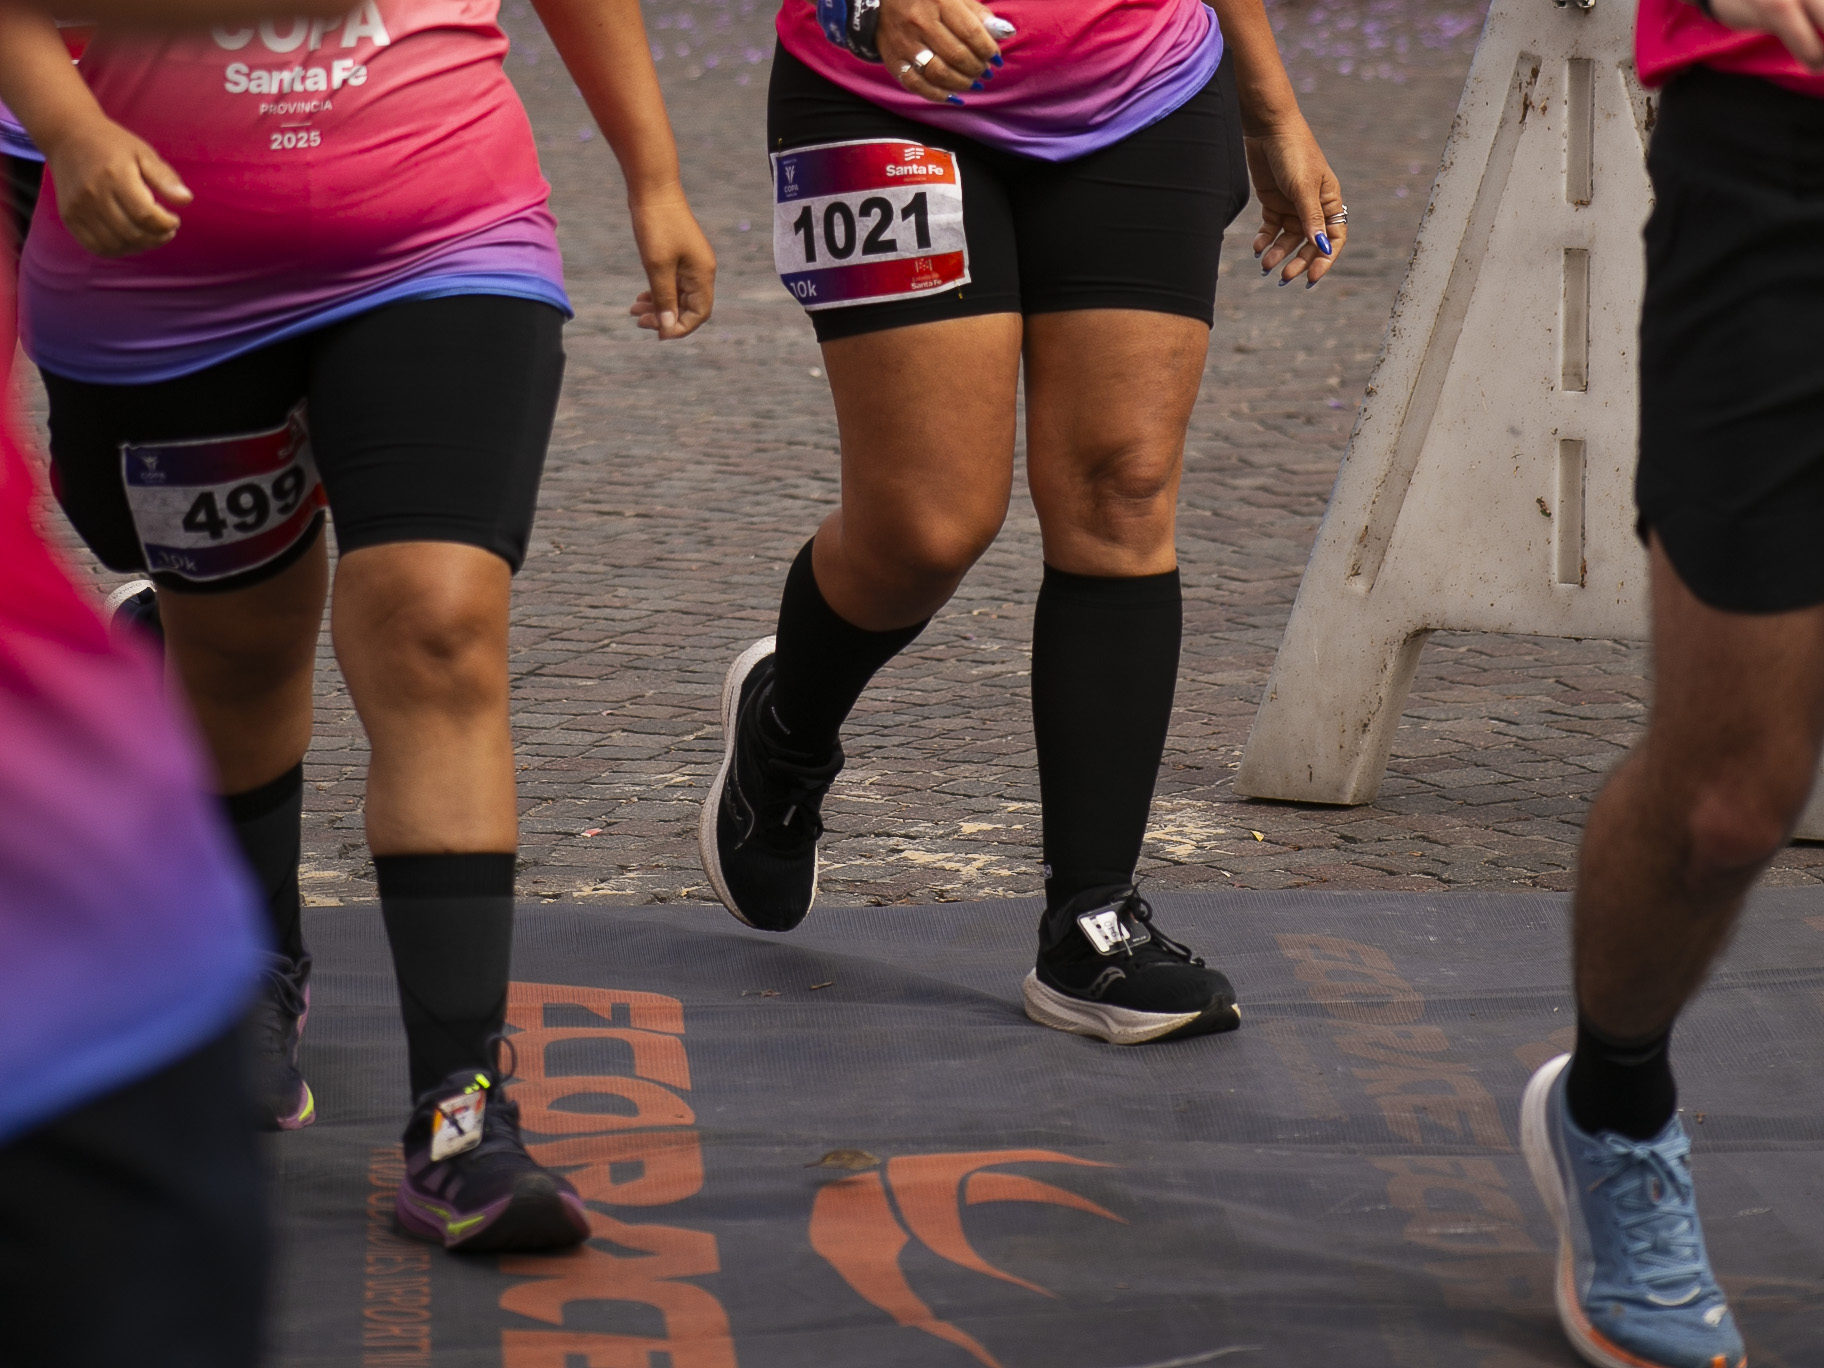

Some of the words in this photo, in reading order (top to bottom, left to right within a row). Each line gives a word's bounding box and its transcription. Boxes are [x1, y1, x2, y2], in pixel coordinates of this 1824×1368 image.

[224, 62, 328, 95] Santa
[331, 58, 368, 91] Fe
[259, 99, 333, 116] PROVINCIA
[270, 130, 321, 150] 2025
[886, 164, 927, 177] Santa
[927, 164, 944, 176] Fe
[783, 183, 800, 194] COPA
[793, 191, 932, 264] 1021
[789, 279, 817, 298] 10k
[911, 280, 933, 290] Santa
[182, 464, 307, 541] 499
